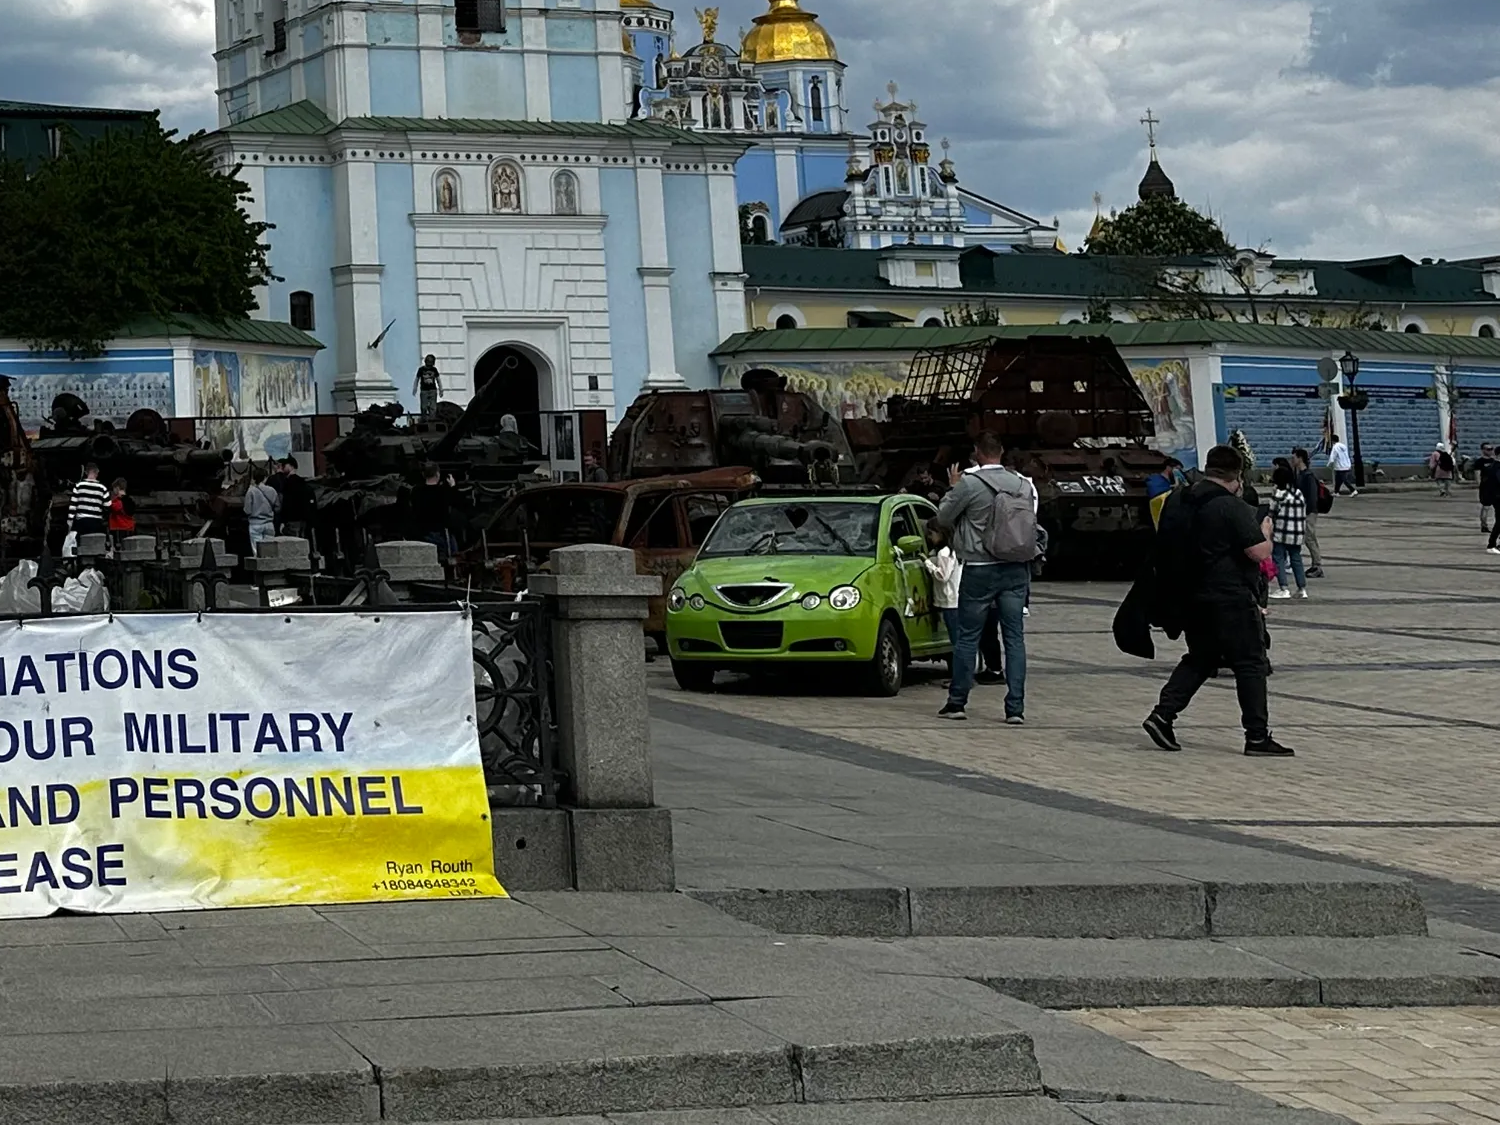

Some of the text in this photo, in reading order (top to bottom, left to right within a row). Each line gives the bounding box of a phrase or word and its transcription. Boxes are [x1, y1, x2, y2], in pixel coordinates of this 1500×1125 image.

[124, 712, 353, 753] MILITARY
[109, 776, 424, 819] PERSONNEL
[386, 859, 473, 877] Ryan Routh
